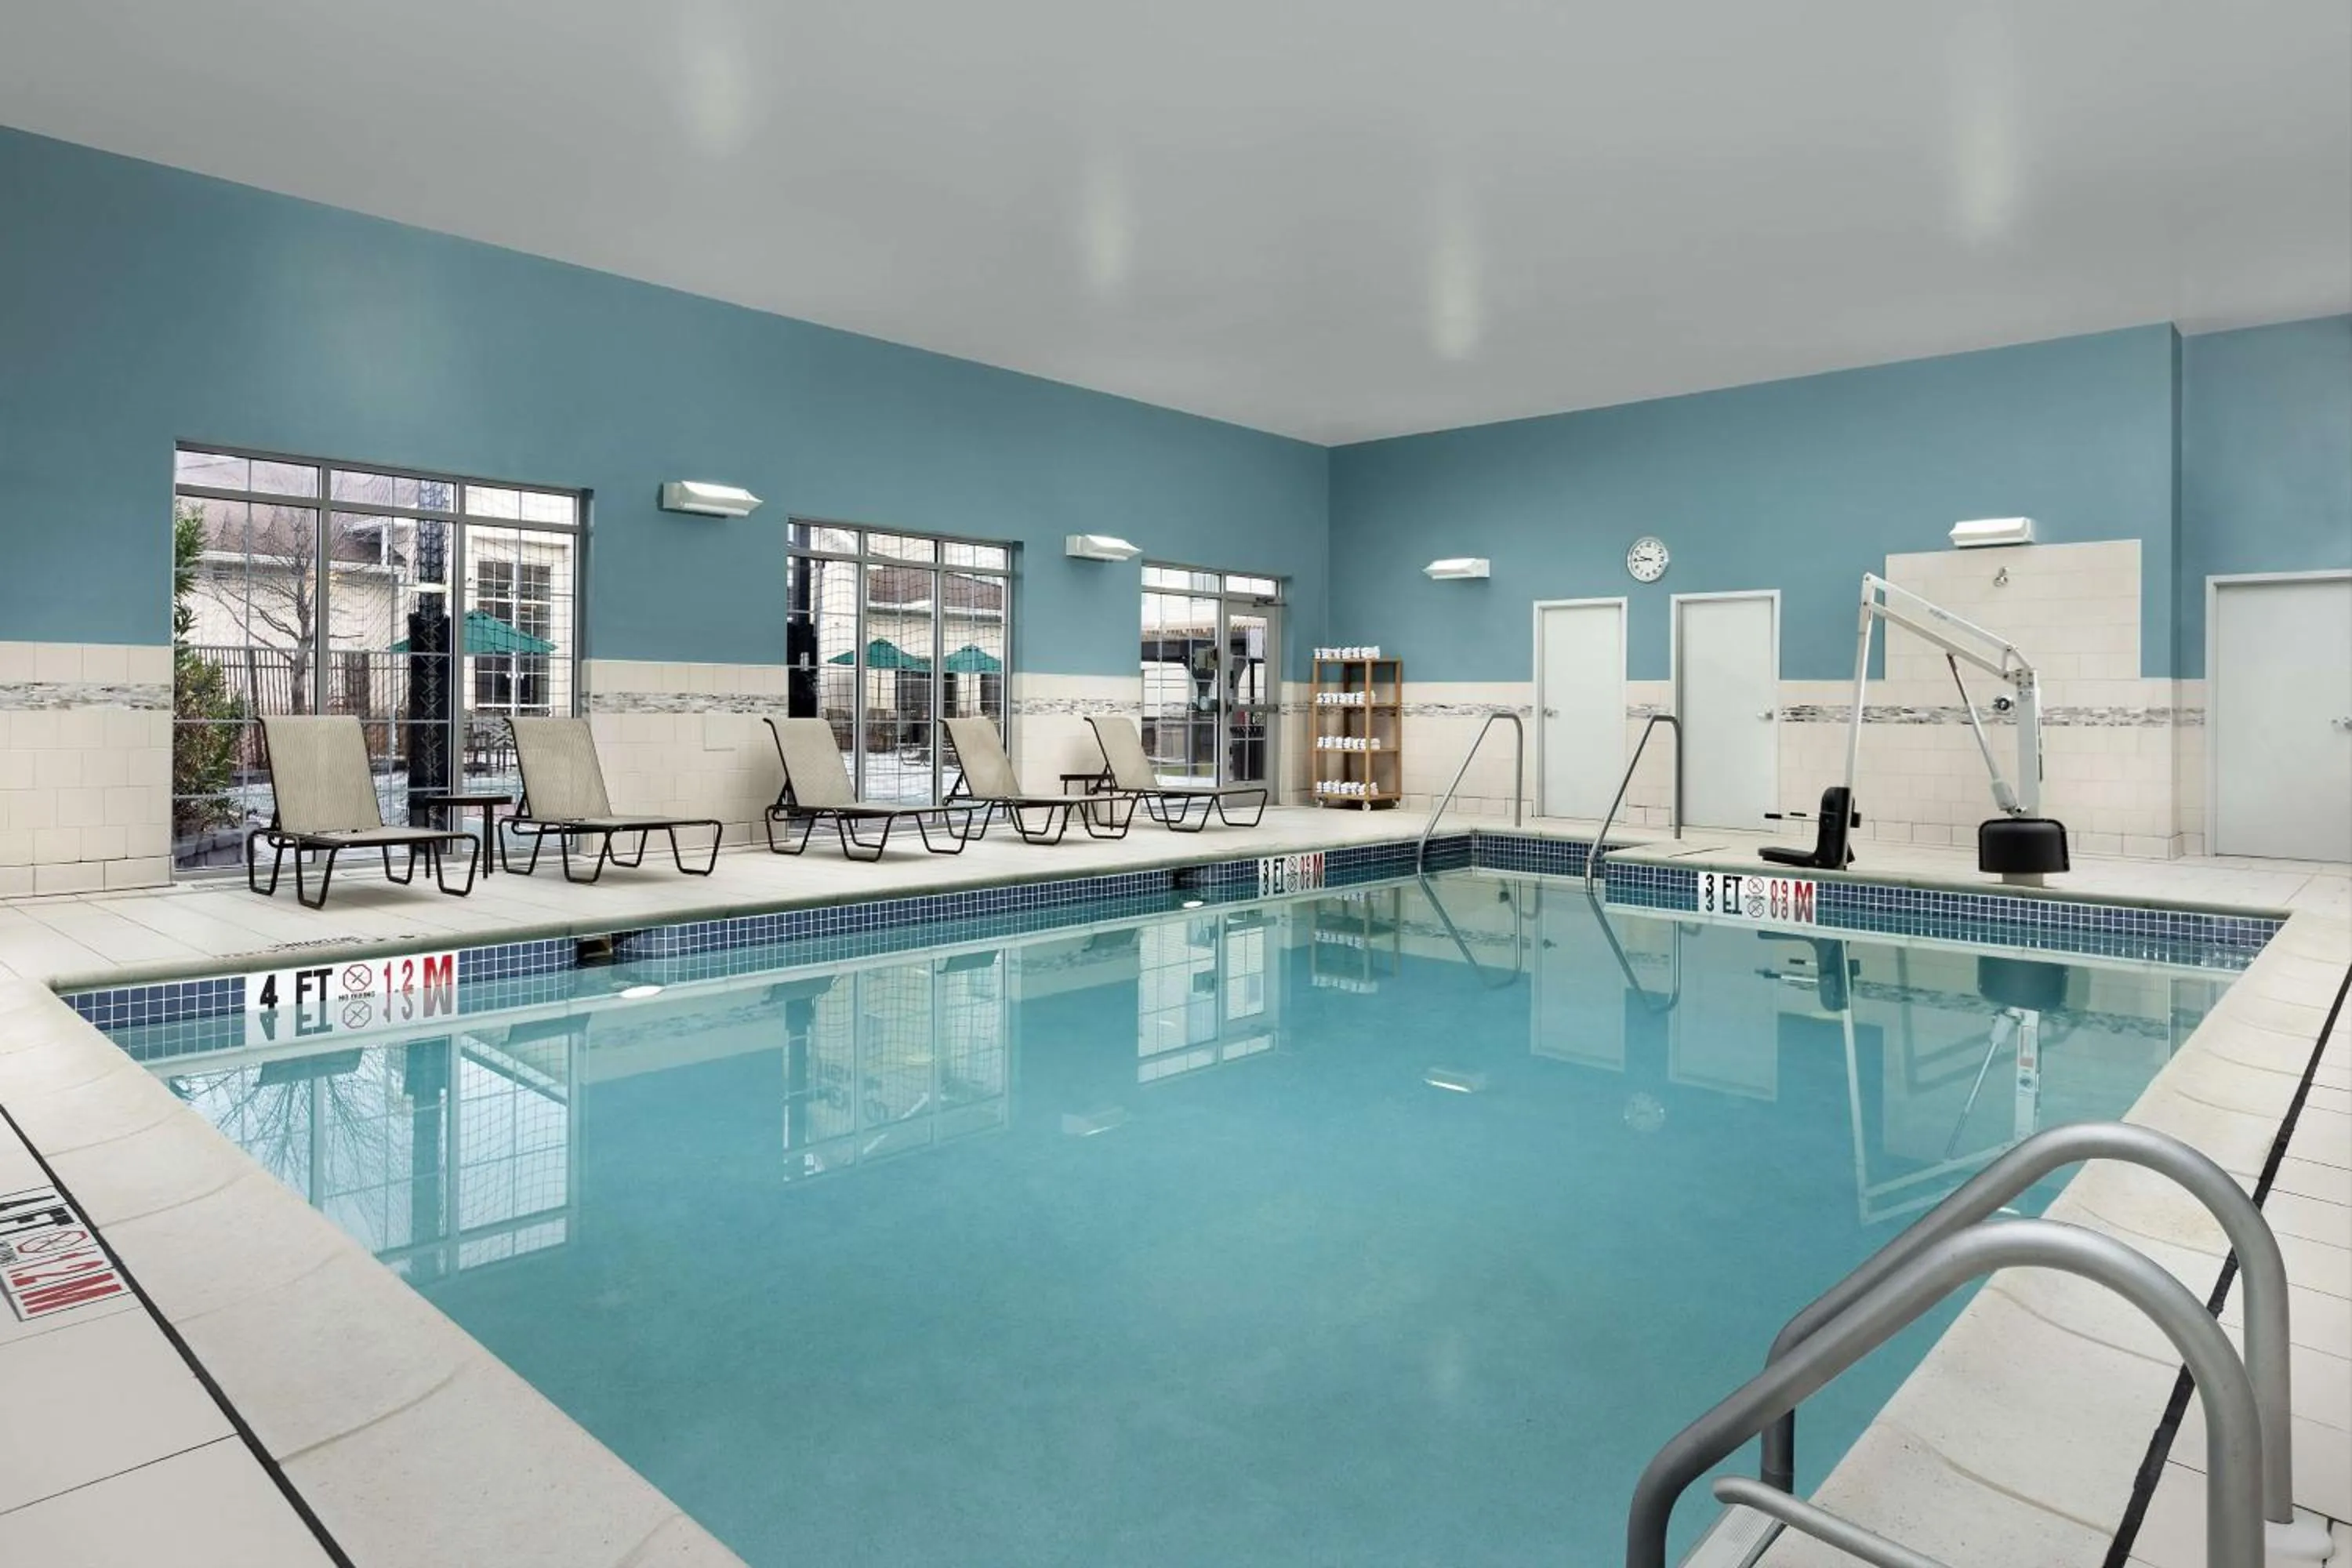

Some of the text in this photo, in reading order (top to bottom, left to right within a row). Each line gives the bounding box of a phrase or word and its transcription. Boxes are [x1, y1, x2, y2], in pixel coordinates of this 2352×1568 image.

[1705, 873, 1742, 896] 3 FT
[1795, 880, 1813, 902] M
[260, 967, 333, 1009] 4 FT
[383, 953, 452, 994] 1.2 M
[20, 1272, 123, 1315] M
